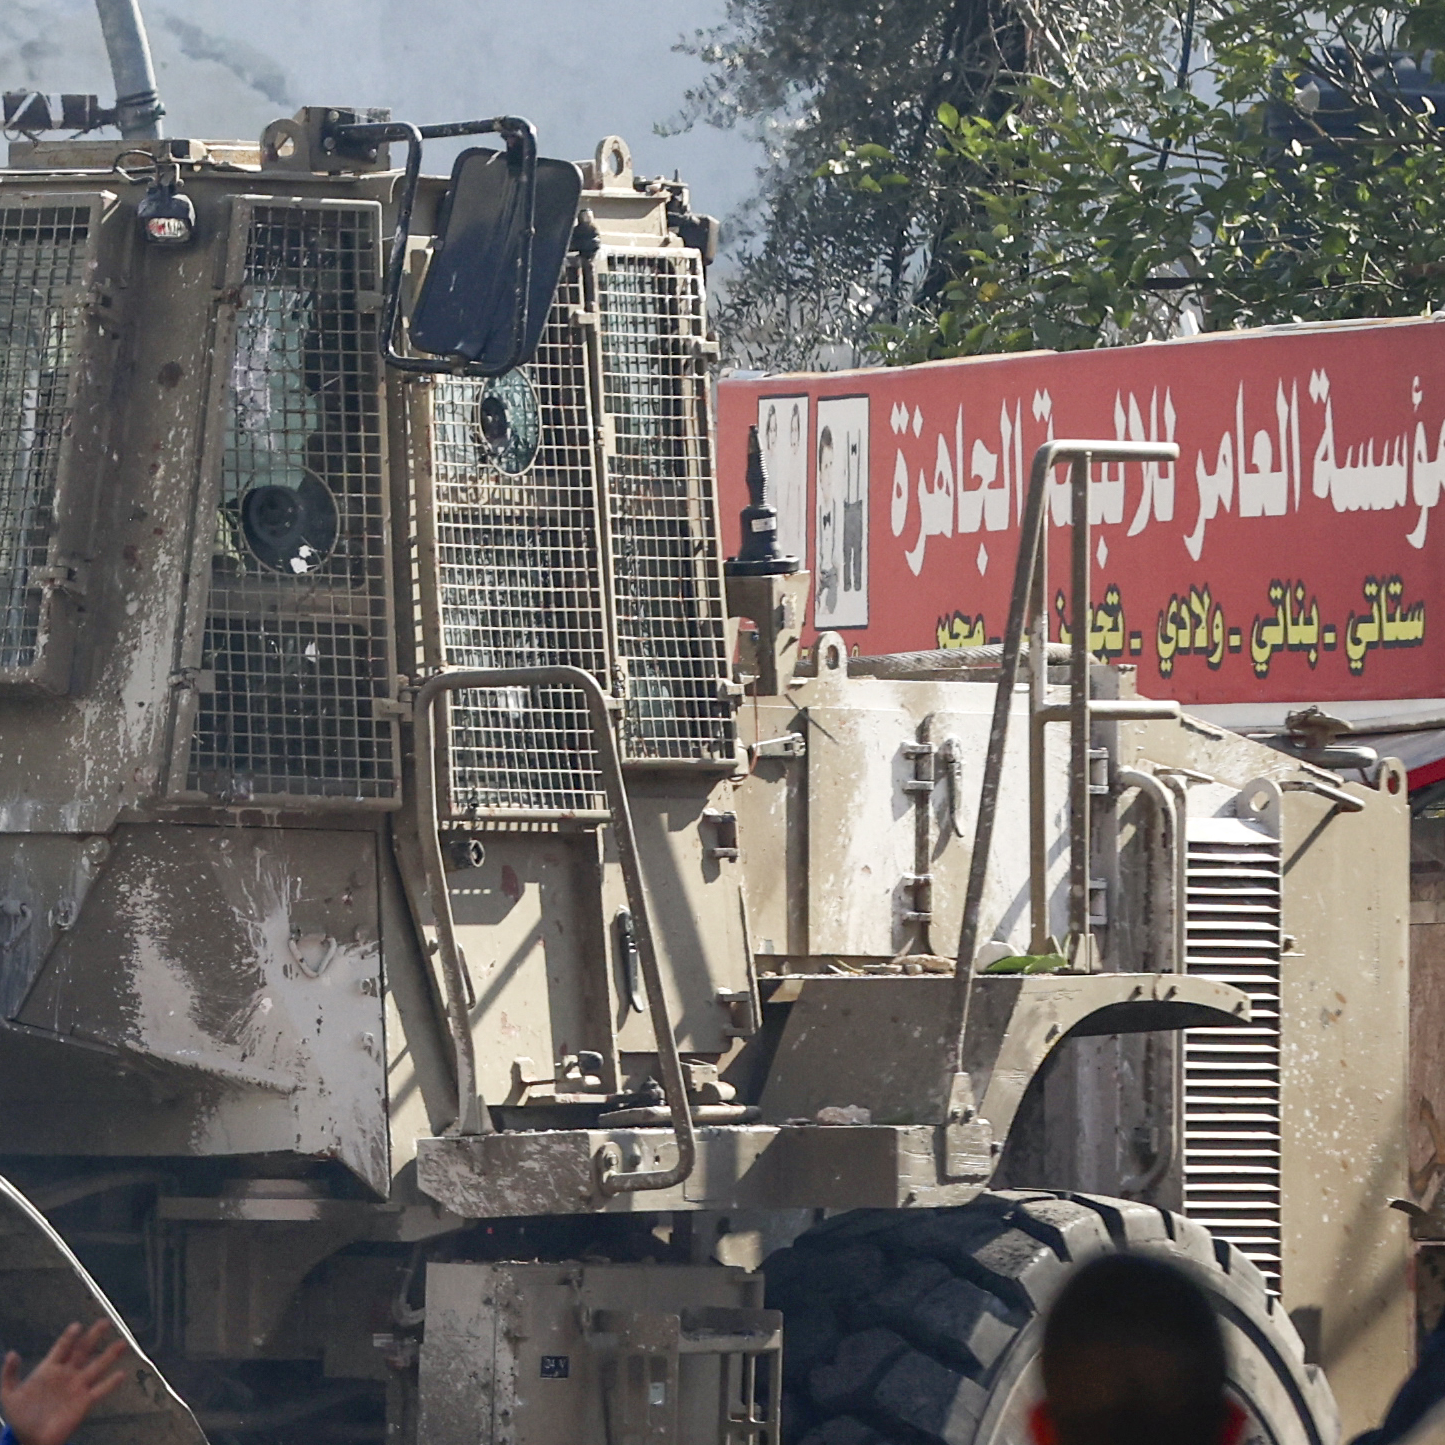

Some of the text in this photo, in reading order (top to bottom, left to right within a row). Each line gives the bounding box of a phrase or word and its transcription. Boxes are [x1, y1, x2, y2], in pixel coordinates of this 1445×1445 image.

[890, 397, 1024, 577] الجاهزة
[1183, 376, 1302, 562] العامر
[1158, 583, 1224, 679] ولادي
[1252, 579, 1319, 679] بناتي
[1346, 575, 1425, 676] ستاتي
